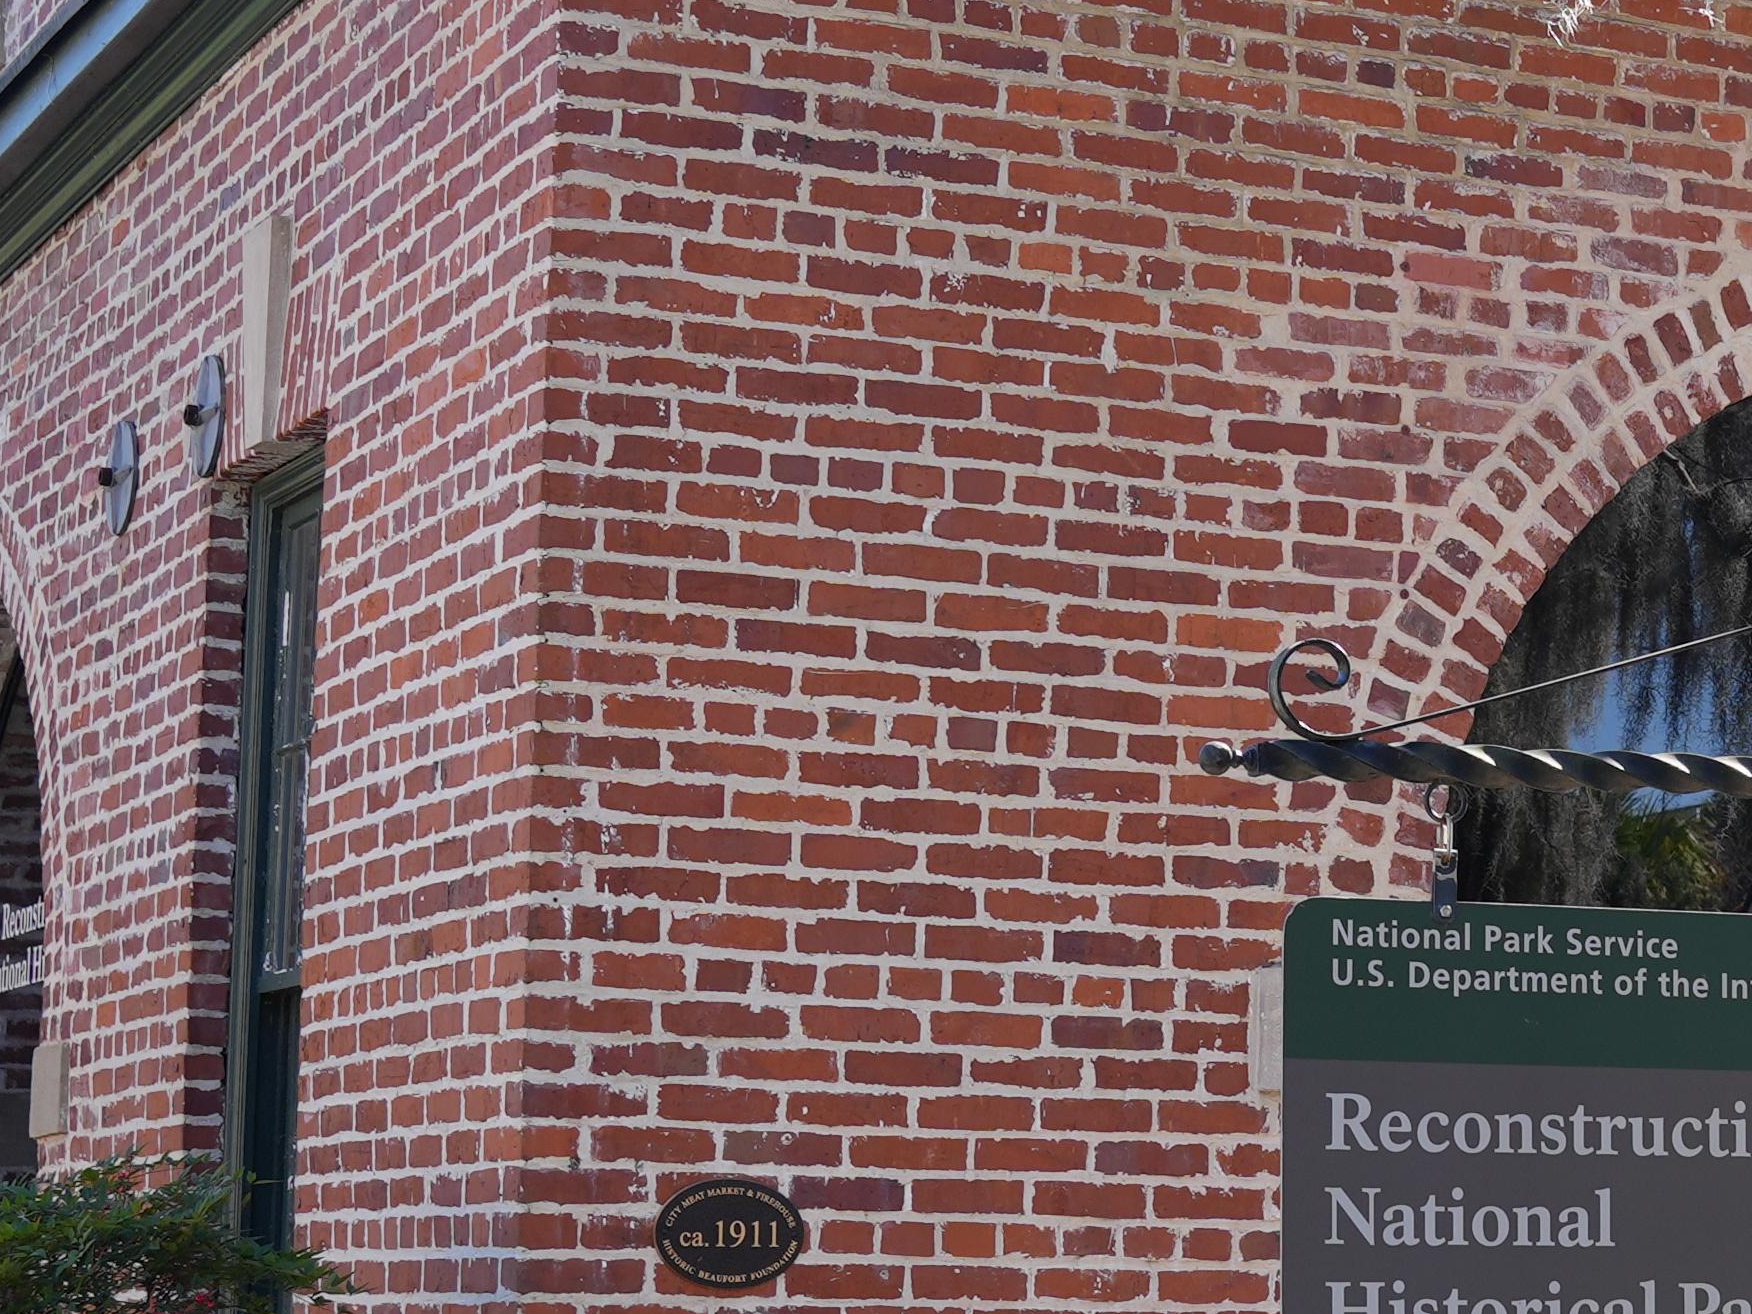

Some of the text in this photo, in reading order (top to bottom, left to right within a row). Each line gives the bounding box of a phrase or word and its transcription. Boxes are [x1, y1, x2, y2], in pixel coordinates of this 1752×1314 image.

[1333, 919, 1678, 958] National Park Service
[1333, 959, 1393, 987] U.S.
[1409, 962, 1602, 997] Department
[1615, 968, 1647, 995] of
[1658, 970, 1708, 997] the
[665, 1187, 796, 1229] CITY MEAT MARKET & FIREHOUSE
[1325, 1187, 1615, 1247] National
[679, 1220, 780, 1248] ca. 1911
[662, 1239, 799, 1283] HISTORIC BEAUFORT FOUNDATION
